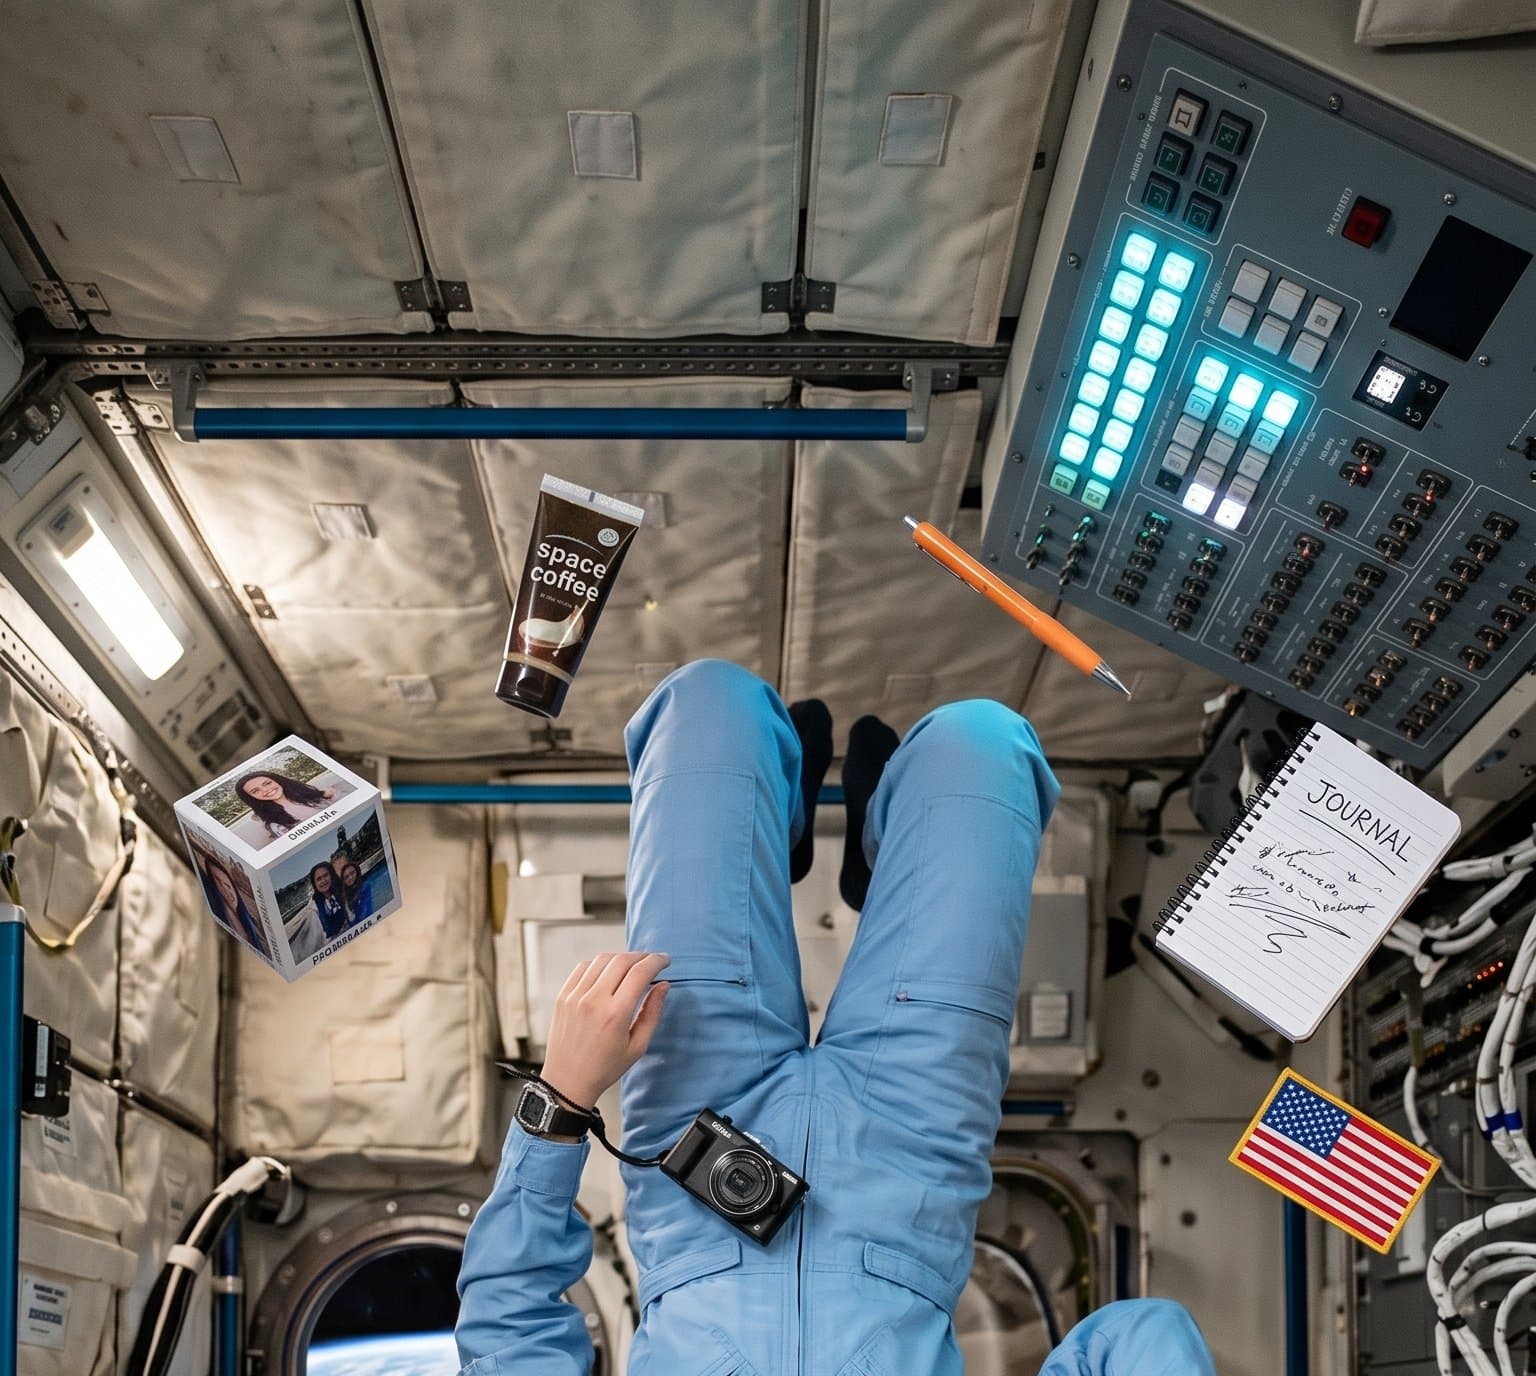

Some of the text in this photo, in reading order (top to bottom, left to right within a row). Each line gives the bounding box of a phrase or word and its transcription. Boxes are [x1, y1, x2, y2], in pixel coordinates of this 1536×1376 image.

[537, 541, 607, 580] space
[530, 566, 599, 602] coffee
[1307, 779, 1416, 863] JOURNAL
